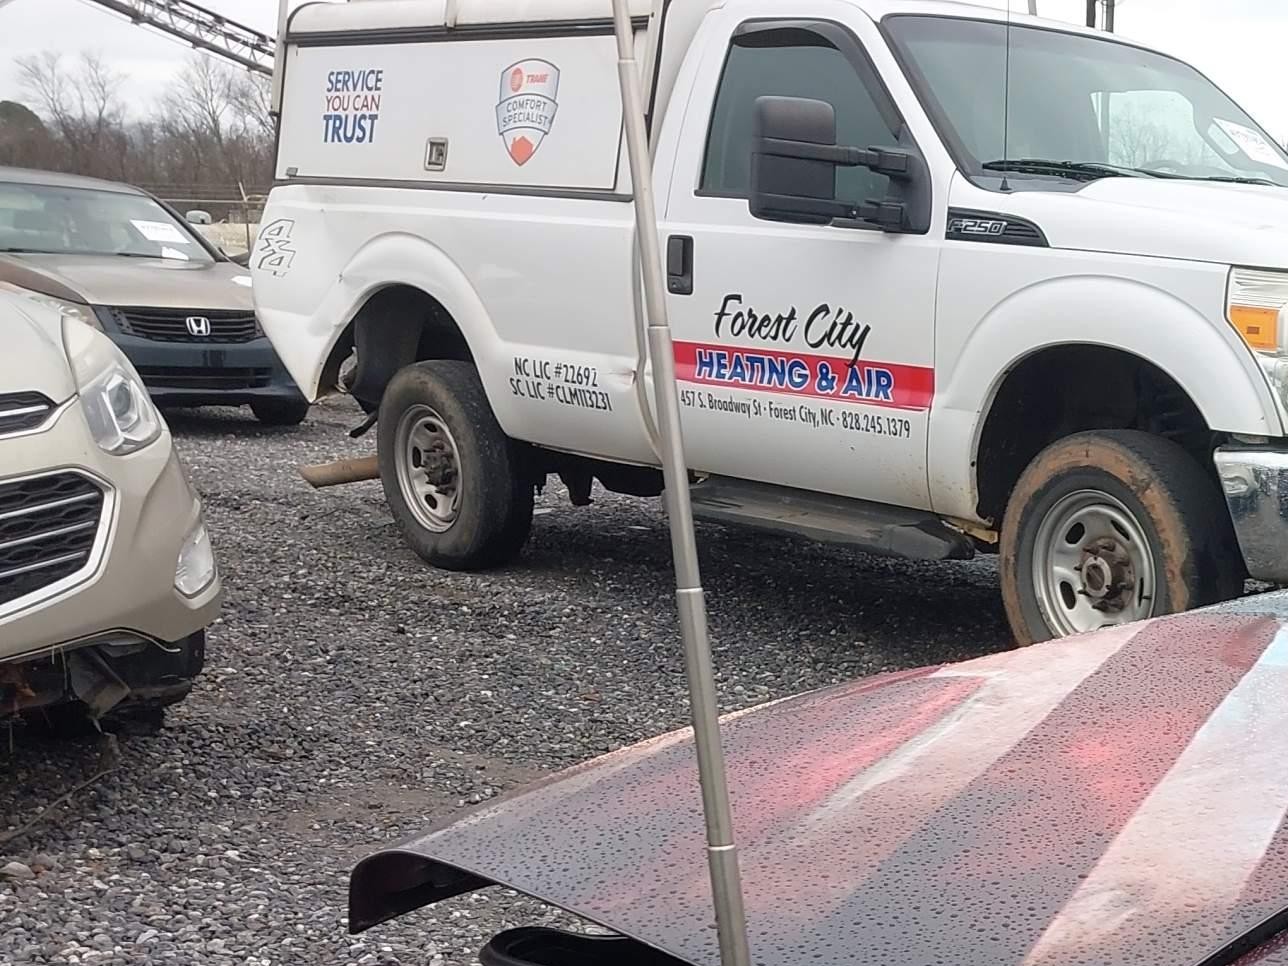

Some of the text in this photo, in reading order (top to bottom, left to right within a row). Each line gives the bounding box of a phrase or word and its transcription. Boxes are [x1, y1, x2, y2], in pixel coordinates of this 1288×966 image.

[326, 69, 384, 93] SERVICE
[526, 73, 549, 84] TRANE
[325, 94, 381, 112] YOU CAN
[506, 98, 547, 113] COMFORT
[322, 114, 378, 143] TRUST
[503, 111, 548, 127] SPECIALIST
[947, 218, 1007, 236] F250
[714, 294, 871, 368] Forest City
[514, 357, 598, 387] NC LIC #22692
[696, 349, 894, 401] HEATING & AIR
[510, 378, 612, 411] SC LIC #CLM113231
[681, 389, 695, 407] 457
[698, 392, 706, 408] S.
[708, 393, 750, 418] Broadway
[753, 399, 762, 416] St
[769, 401, 797, 420] Forest
[799, 405, 819, 428] City,
[820, 408, 835, 426] NC
[842, 411, 911, 438] 828.245.1379
